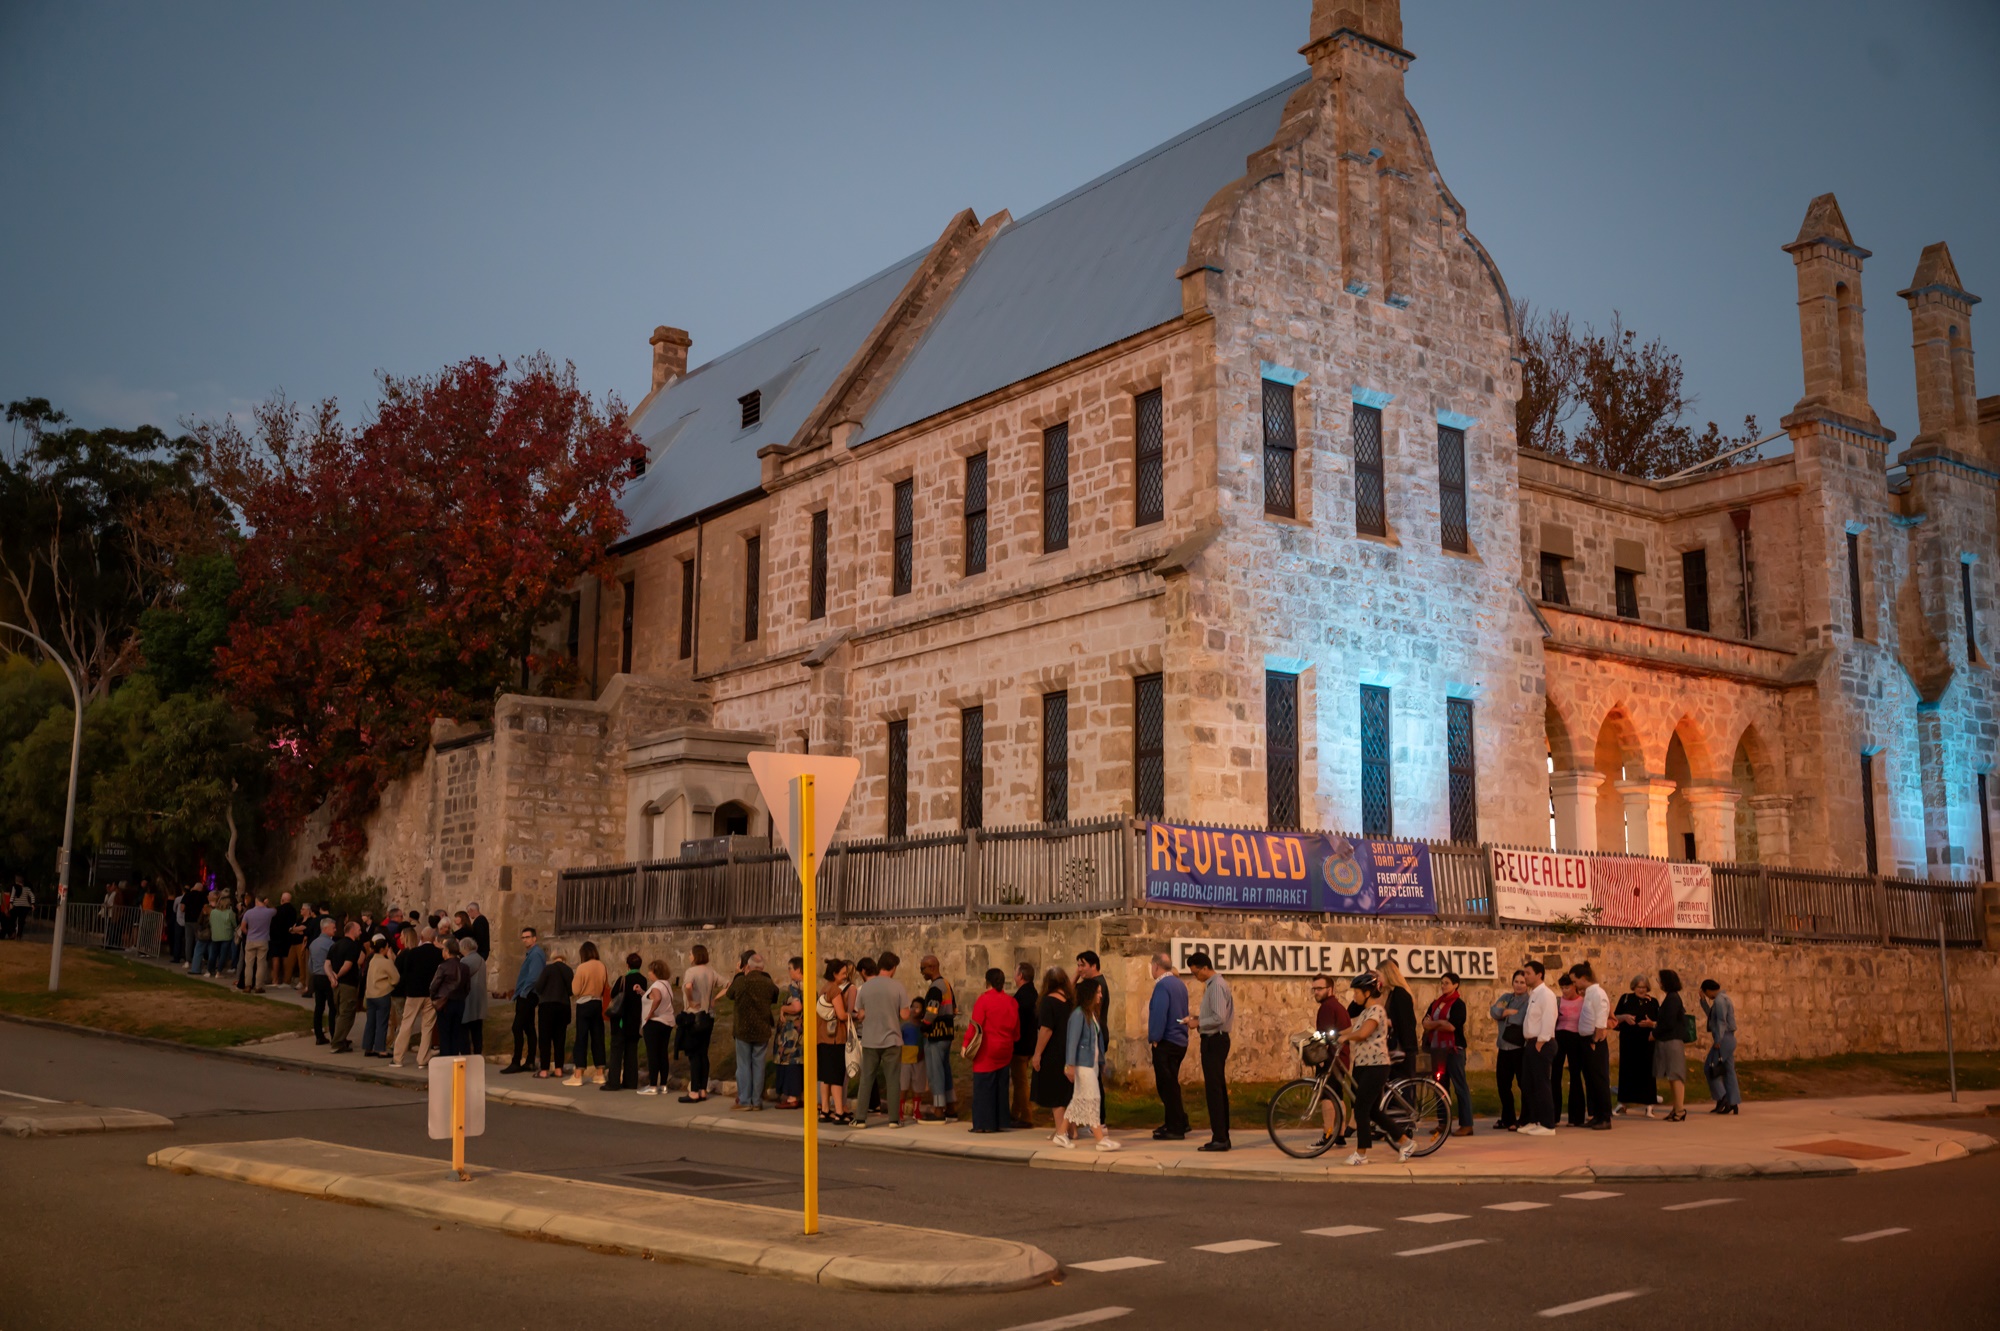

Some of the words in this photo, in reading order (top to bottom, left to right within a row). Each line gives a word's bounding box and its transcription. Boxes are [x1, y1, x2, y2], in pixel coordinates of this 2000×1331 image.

[1151, 824, 1307, 880] REVEALED
[1371, 843, 1386, 854] SAT
[1387, 843, 1395, 854] 11
[1396, 844, 1413, 855] MAY
[1373, 855, 1395, 867] 10AM
[1402, 856, 1419, 867] 5PM
[1494, 850, 1587, 889] REVEALED
[1672, 865, 1682, 875] FRI
[1690, 866, 1703, 876] MAY
[1376, 872, 1419, 885] FREMANTLE
[1151, 880, 1170, 897] WA
[1173, 882, 1239, 902] ABORIGINAL
[1242, 886, 1263, 903] ART
[1266, 888, 1308, 905] MARKET
[1378, 885, 1397, 897] ARTS
[1397, 885, 1424, 898] CENTRE
[1677, 901, 1709, 912] FREMANTLE
[1677, 913, 1692, 923] ARTS
[1340, 947, 1399, 973] ARTS
[1407, 948, 1495, 975] CENTRE
